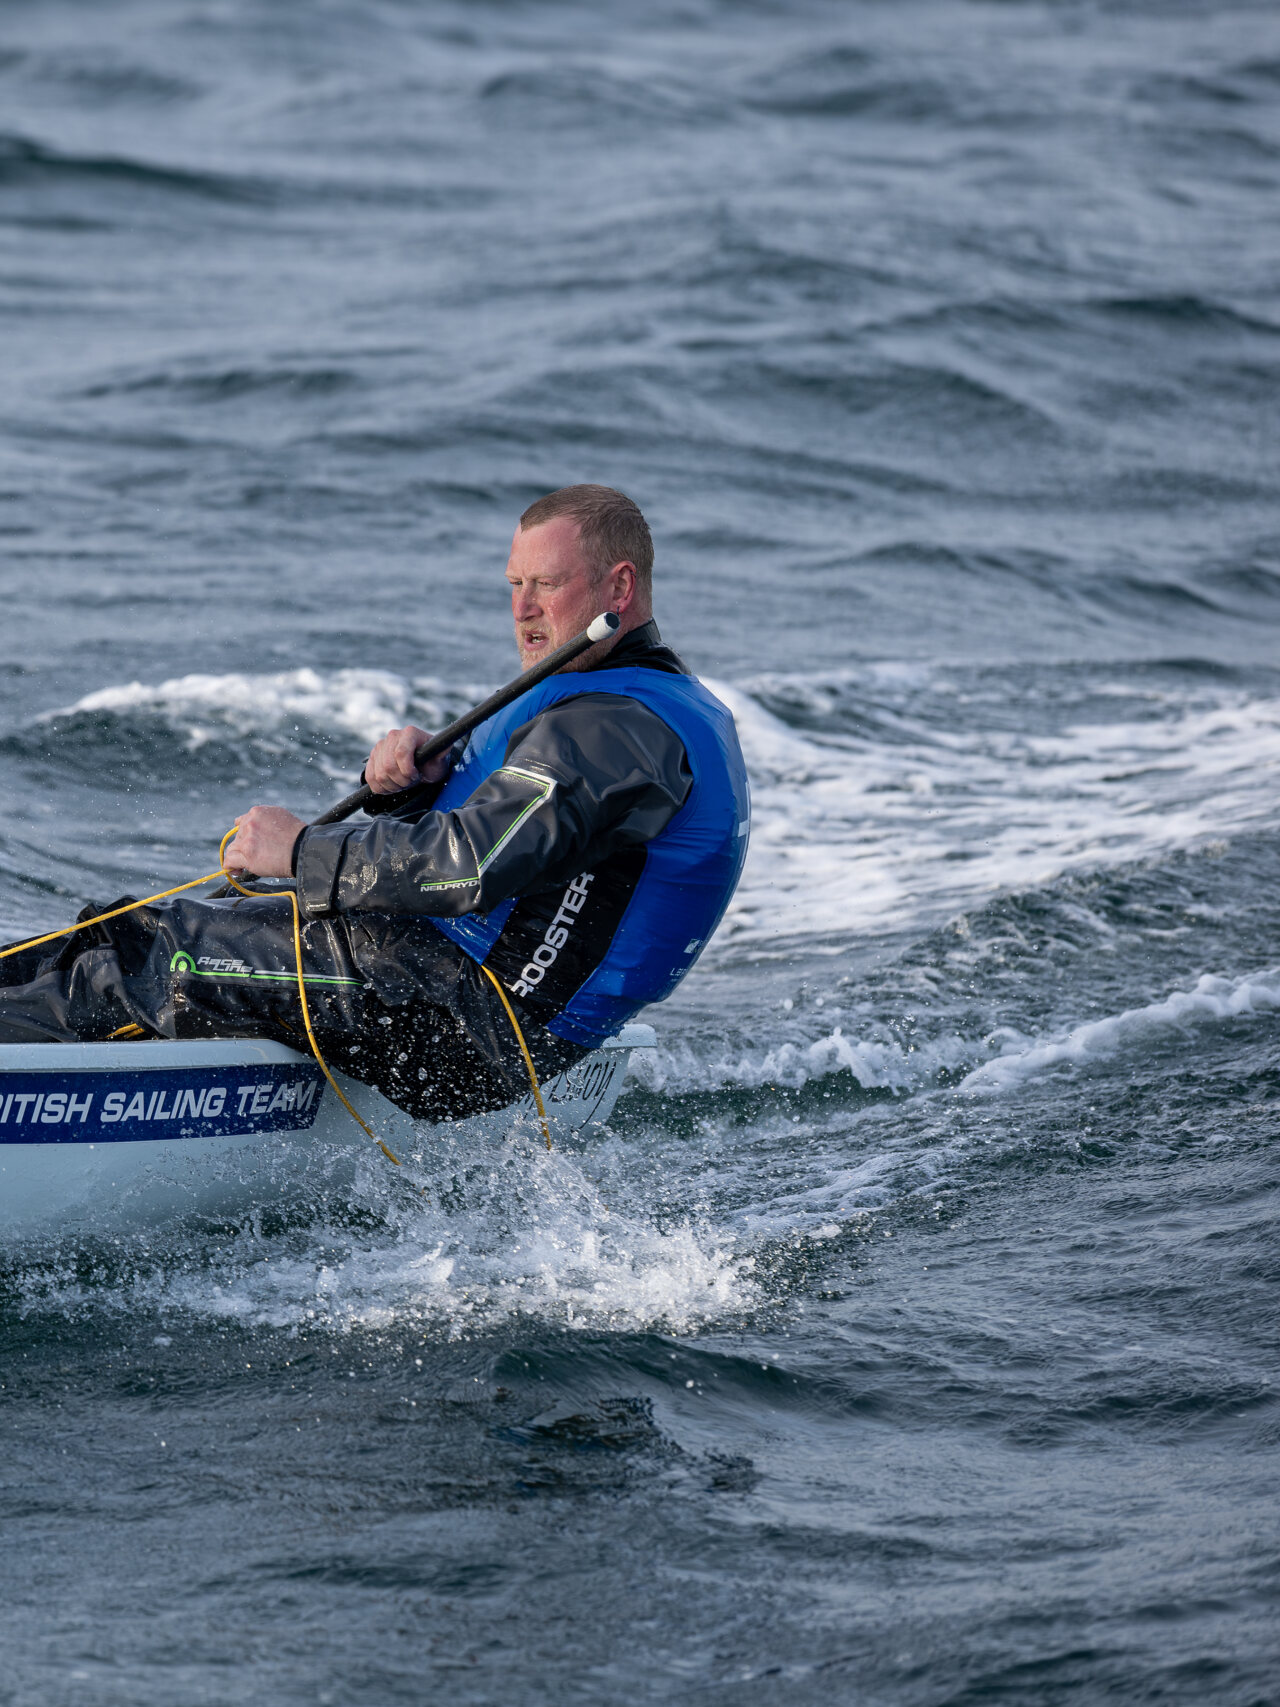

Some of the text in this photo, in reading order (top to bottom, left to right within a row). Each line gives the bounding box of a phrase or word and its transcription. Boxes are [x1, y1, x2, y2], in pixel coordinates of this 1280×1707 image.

[420, 880, 480, 893] NEILPRYD
[510, 871, 595, 998] ROOSTER
[100, 1088, 226, 1122] SAILING
[235, 1081, 317, 1115] TEAM
